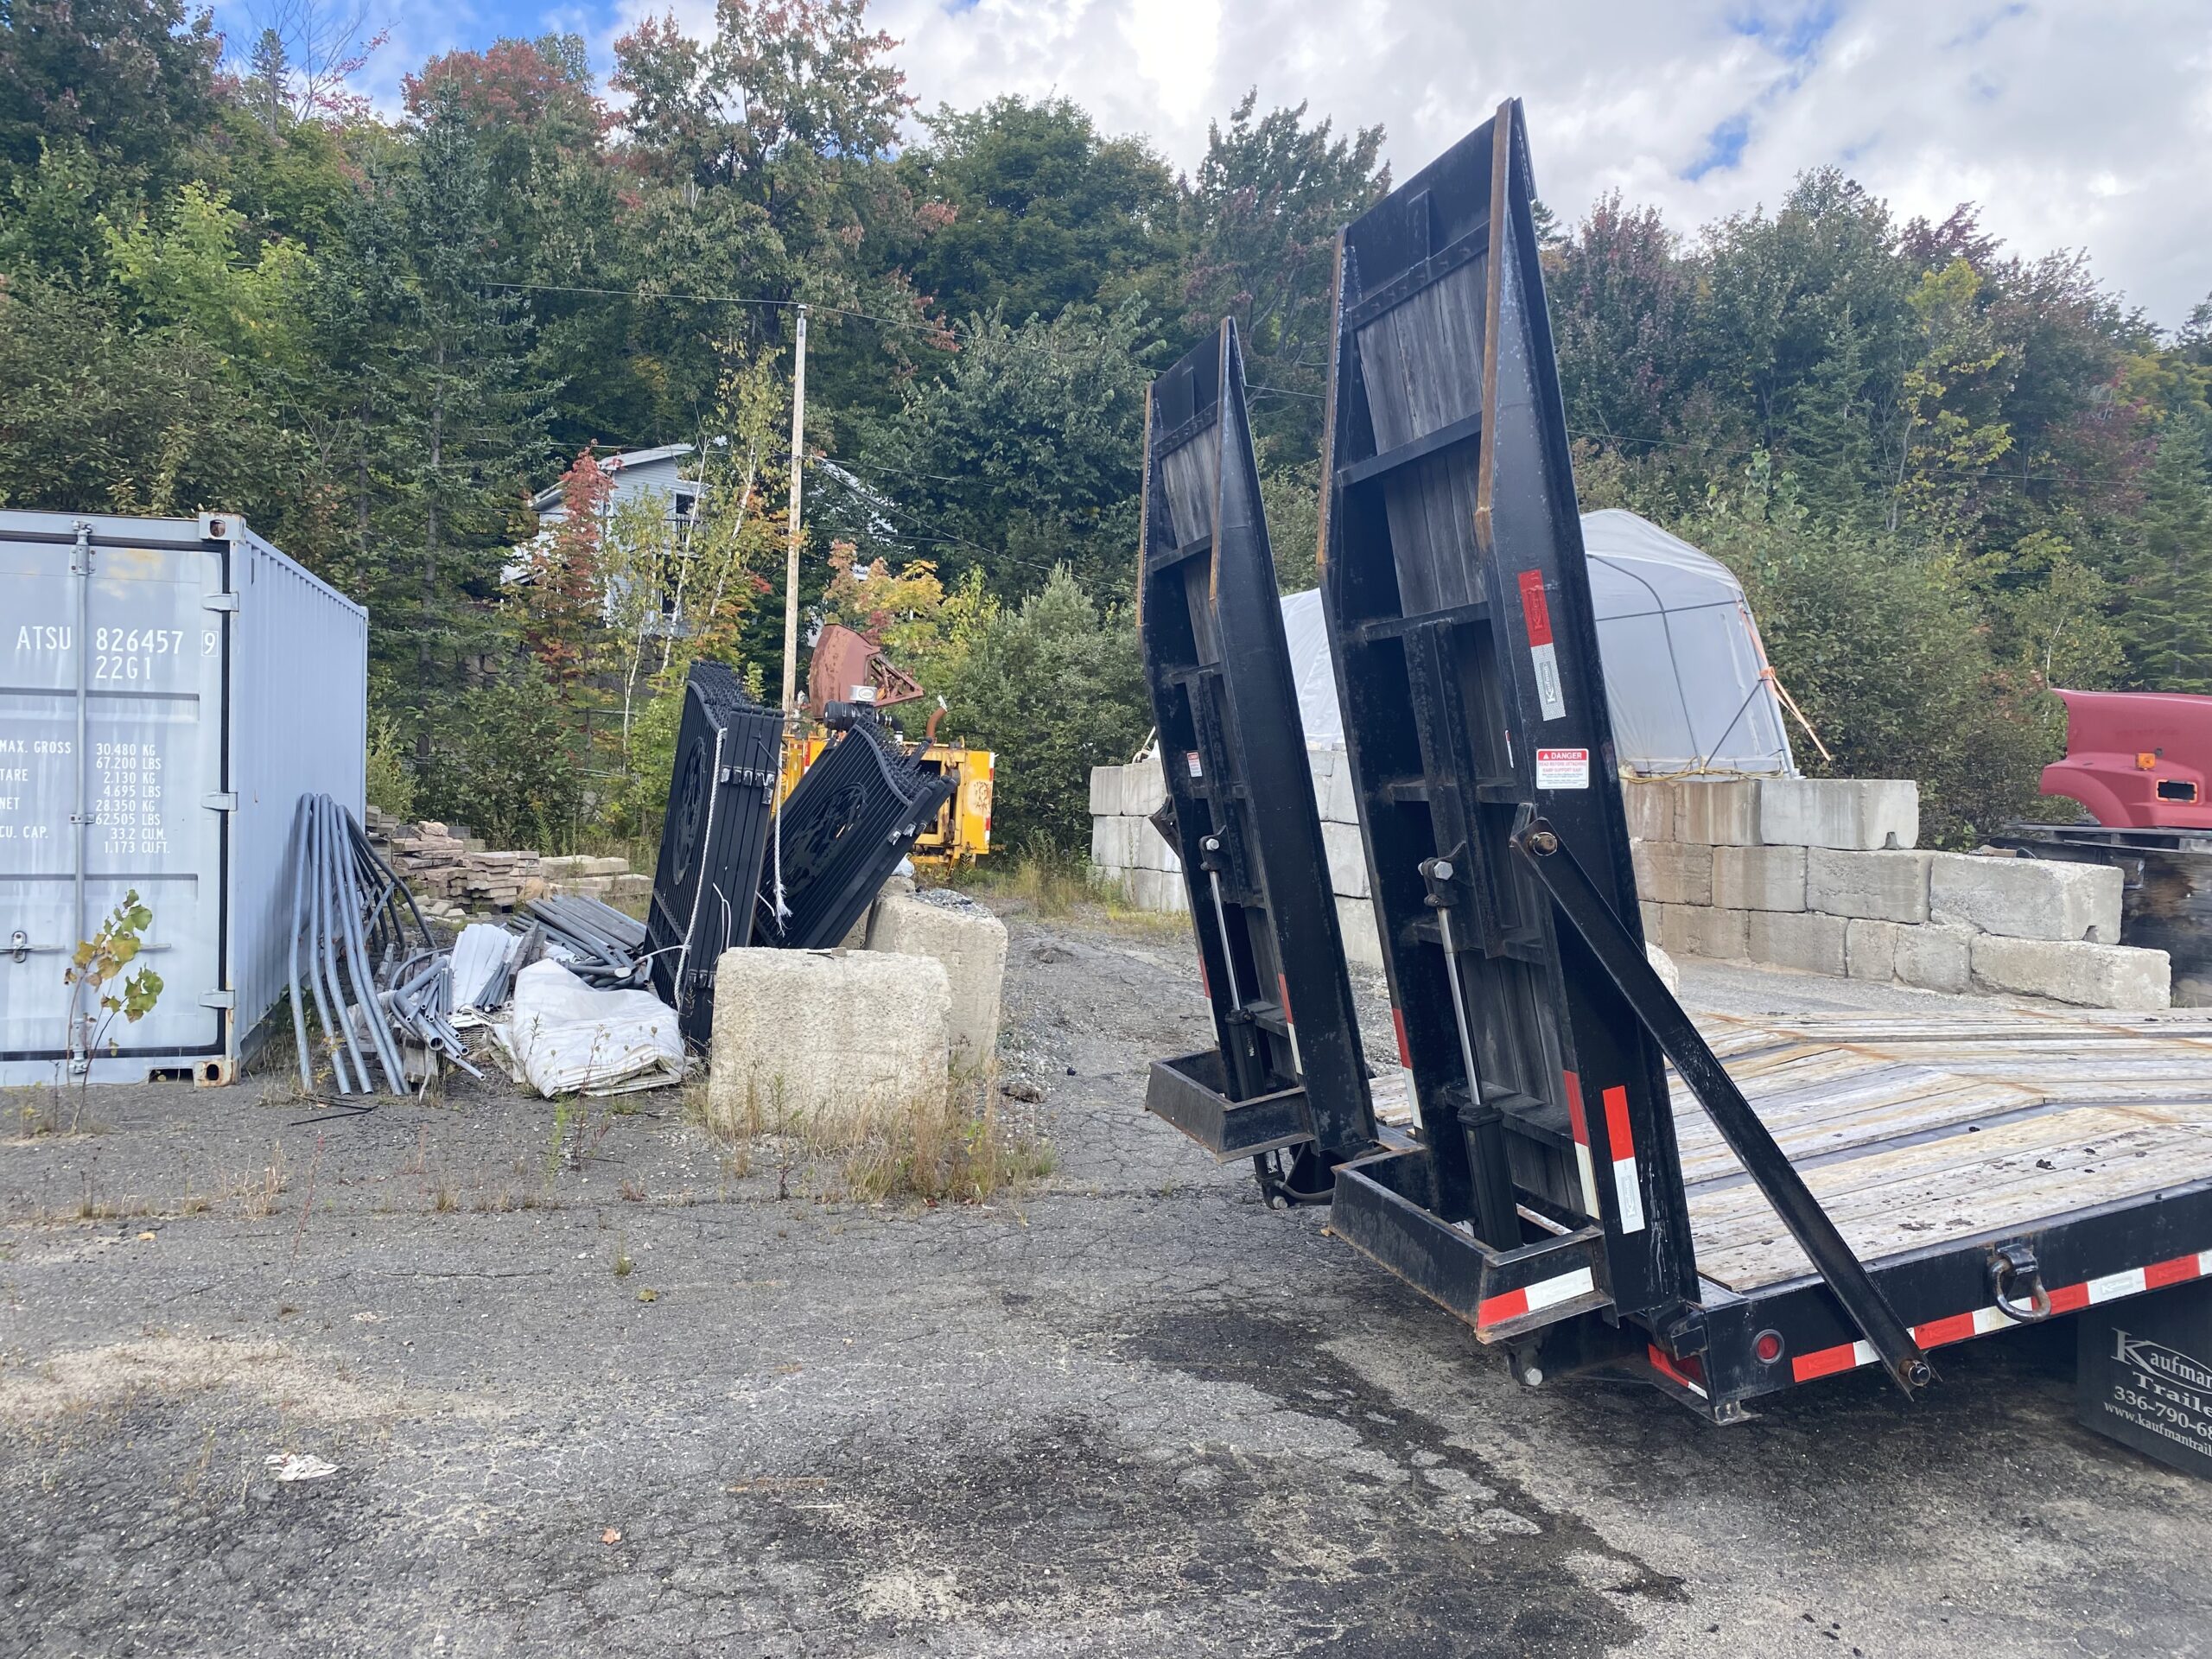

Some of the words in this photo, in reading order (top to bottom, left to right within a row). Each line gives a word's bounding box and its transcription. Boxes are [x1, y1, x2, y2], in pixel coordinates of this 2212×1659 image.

[16, 626, 71, 650] ATSU
[96, 627, 183, 654] 826457
[203, 632, 217, 655] 9
[95, 655, 150, 680] 22G1
[0, 740, 28, 753] MAX.
[34, 741, 71, 754] GROSS
[96, 743, 137, 756] 30.480
[143, 744, 156, 757] KG
[96, 757, 137, 769] 67.200
[143, 758, 162, 770] LBS
[0, 768, 29, 782] TARE
[104, 772, 137, 784] 2.130
[143, 772, 156, 785] KG
[104, 785, 136, 798] 4.695
[143, 785, 162, 798] LBS
[0, 797, 20, 810] NET
[95, 799, 136, 812] 28.350
[142, 800, 156, 812] KG
[95, 813, 136, 825] 62.505
[142, 814, 161, 826] LBS
[0, 825, 17, 838] CU.
[22, 826, 49, 839] CAP.
[111, 828, 136, 840] 33.2
[105, 841, 136, 854] 1.173
